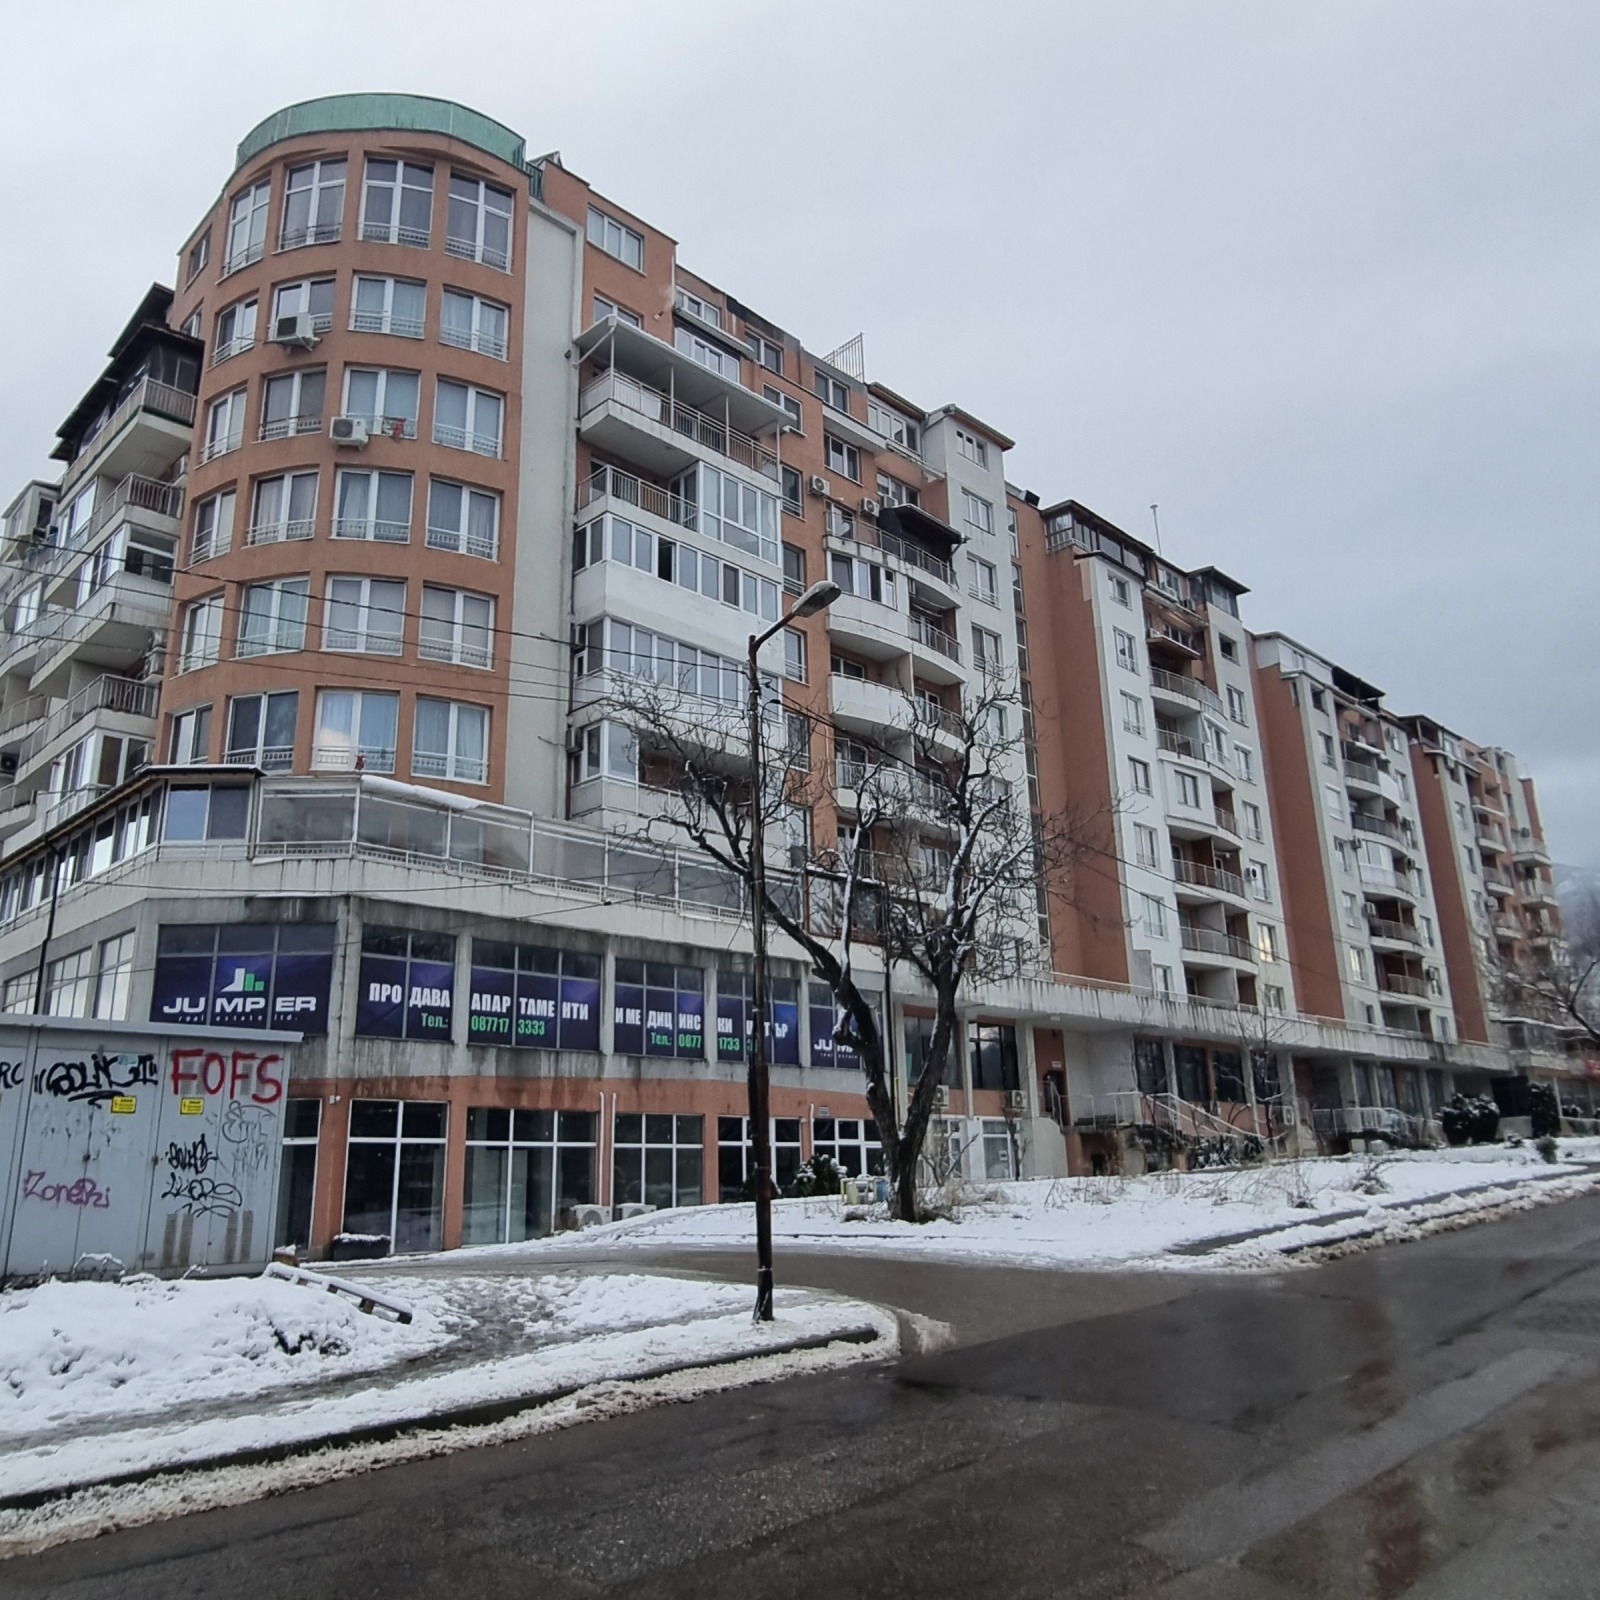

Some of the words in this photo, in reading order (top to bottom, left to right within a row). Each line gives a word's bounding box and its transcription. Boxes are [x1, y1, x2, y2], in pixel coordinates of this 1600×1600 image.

[163, 996, 317, 1013] JUMPER
[746, 1020, 789, 1038] ЦТЪР
[171, 1048, 282, 1104] FOFS
